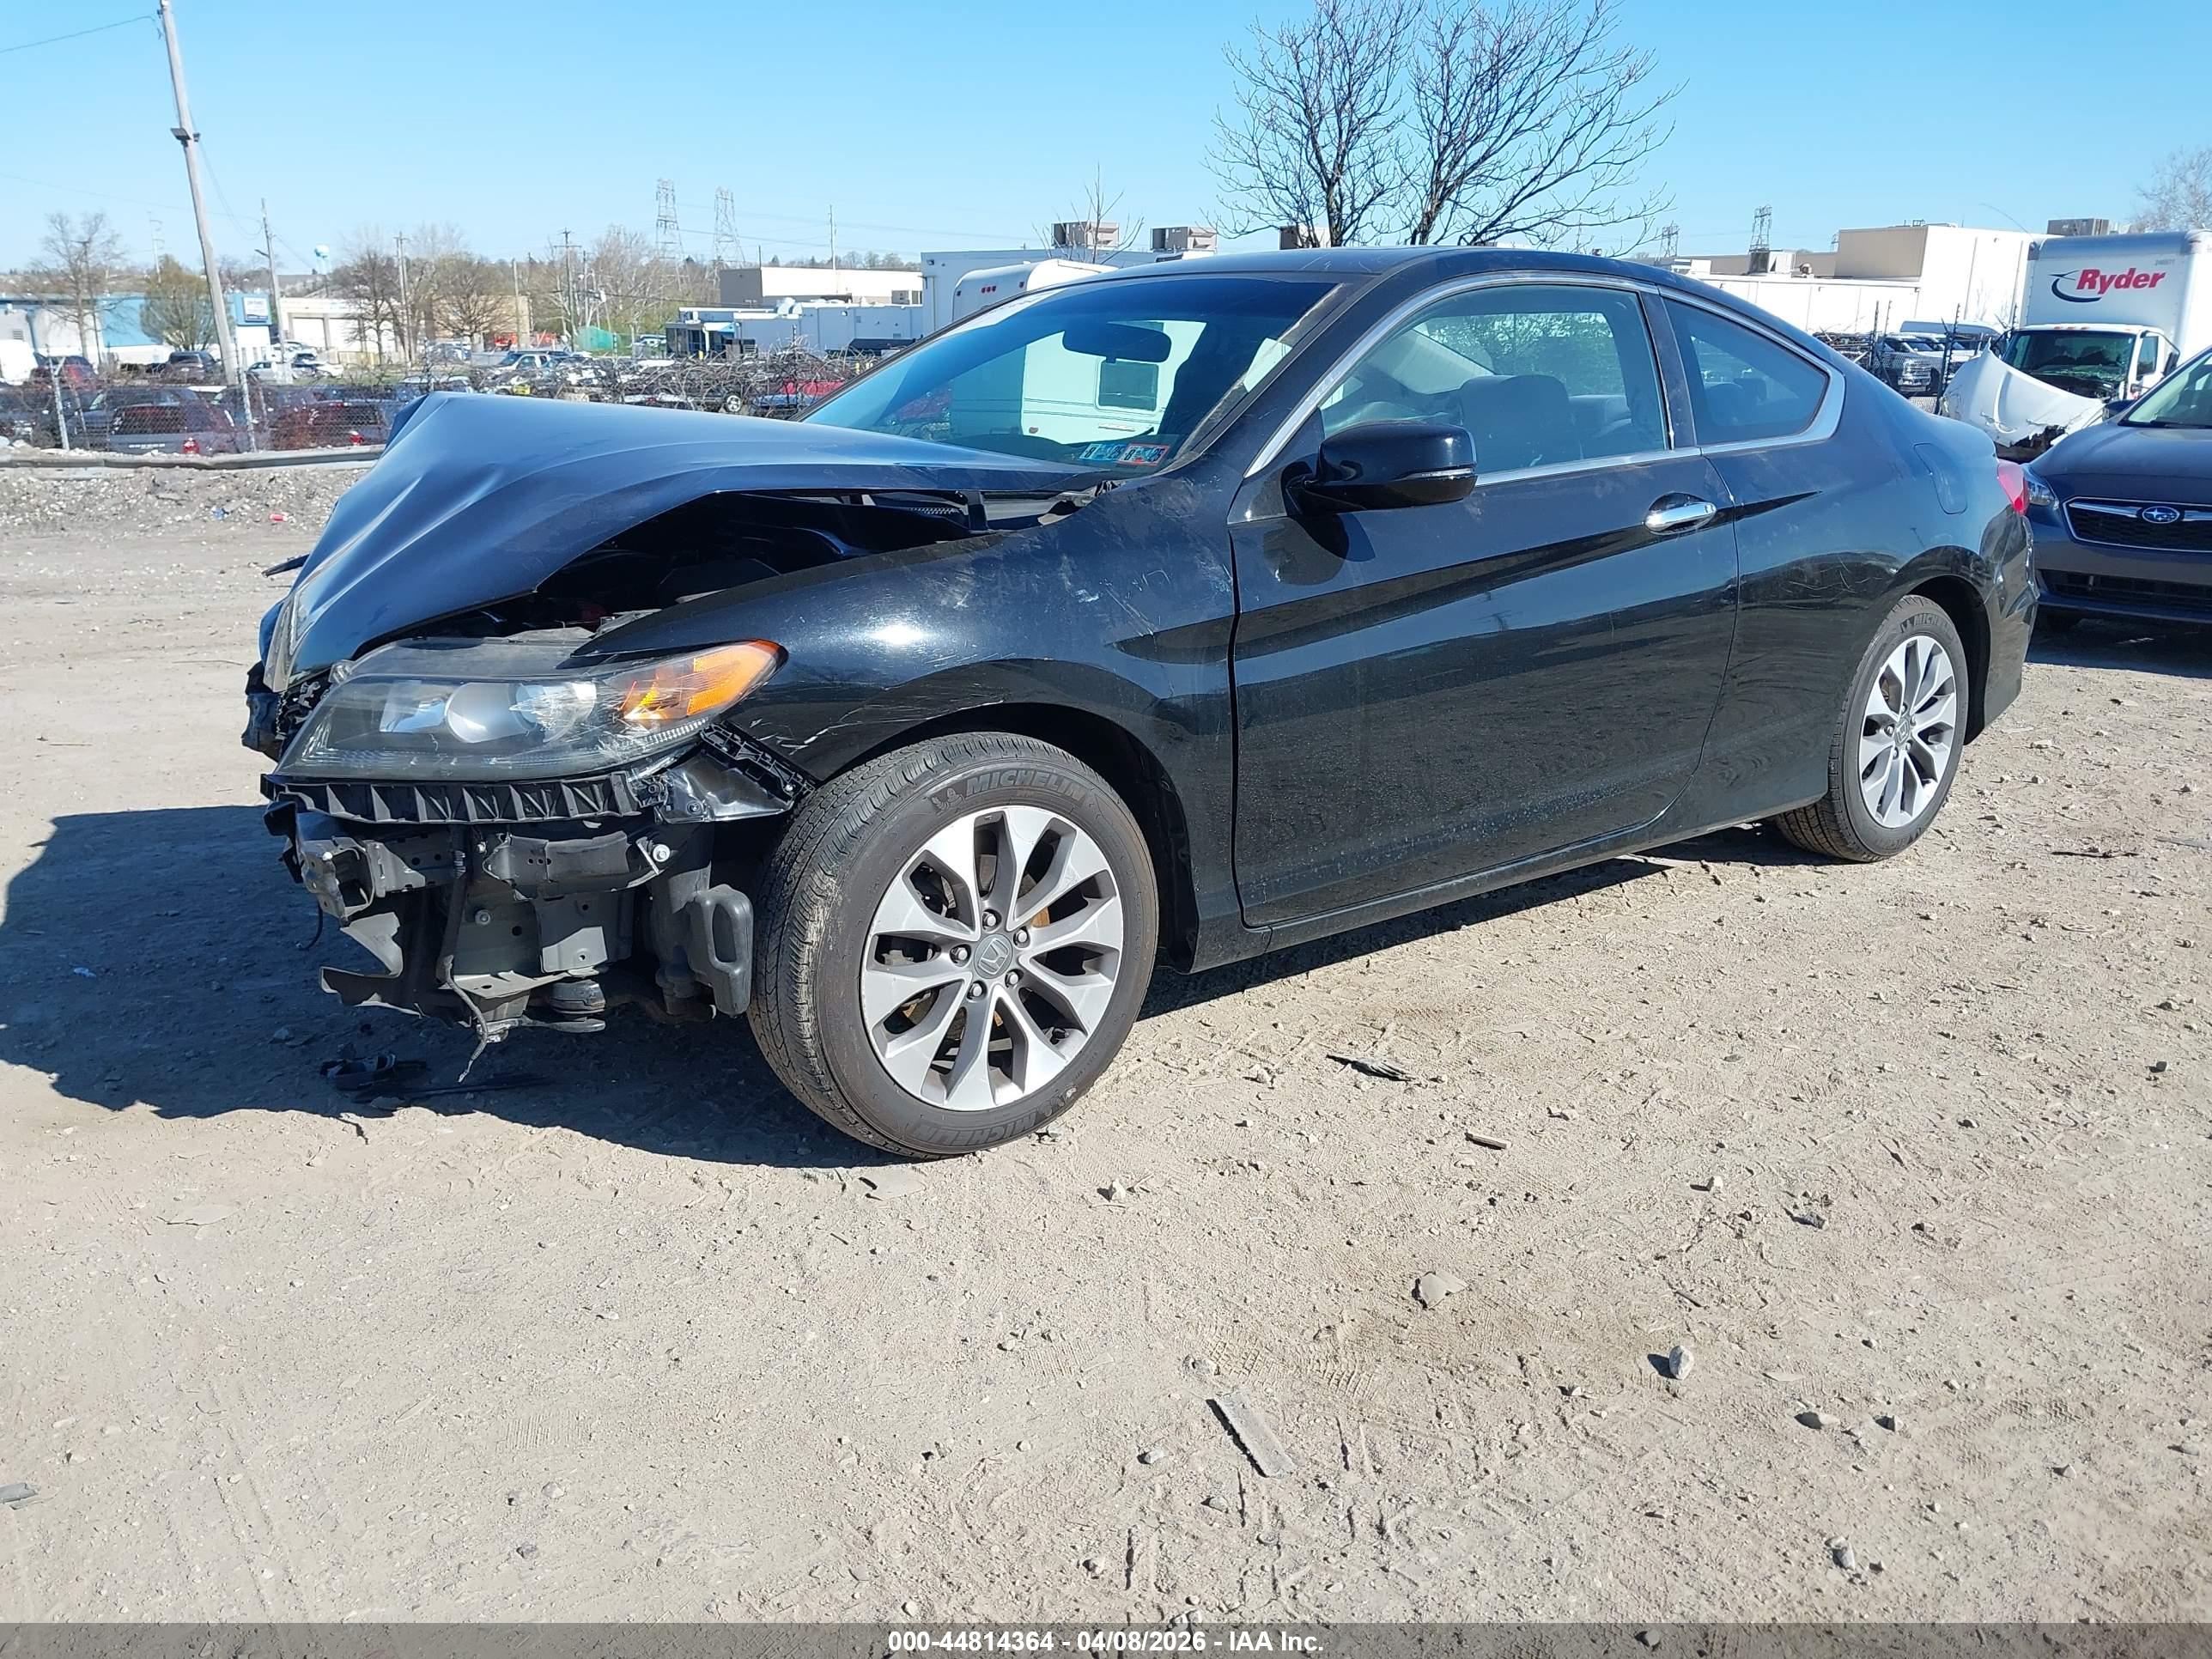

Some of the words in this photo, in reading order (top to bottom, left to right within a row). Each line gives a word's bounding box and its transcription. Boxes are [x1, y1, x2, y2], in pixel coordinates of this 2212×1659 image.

[2075, 267, 2166, 295] Ryder
[1085, 447, 1097, 459] 8
[1123, 449, 1135, 460] 8
[966, 769, 1086, 801] MICHELIN
[913, 1112, 1037, 1146] MICHELIN
